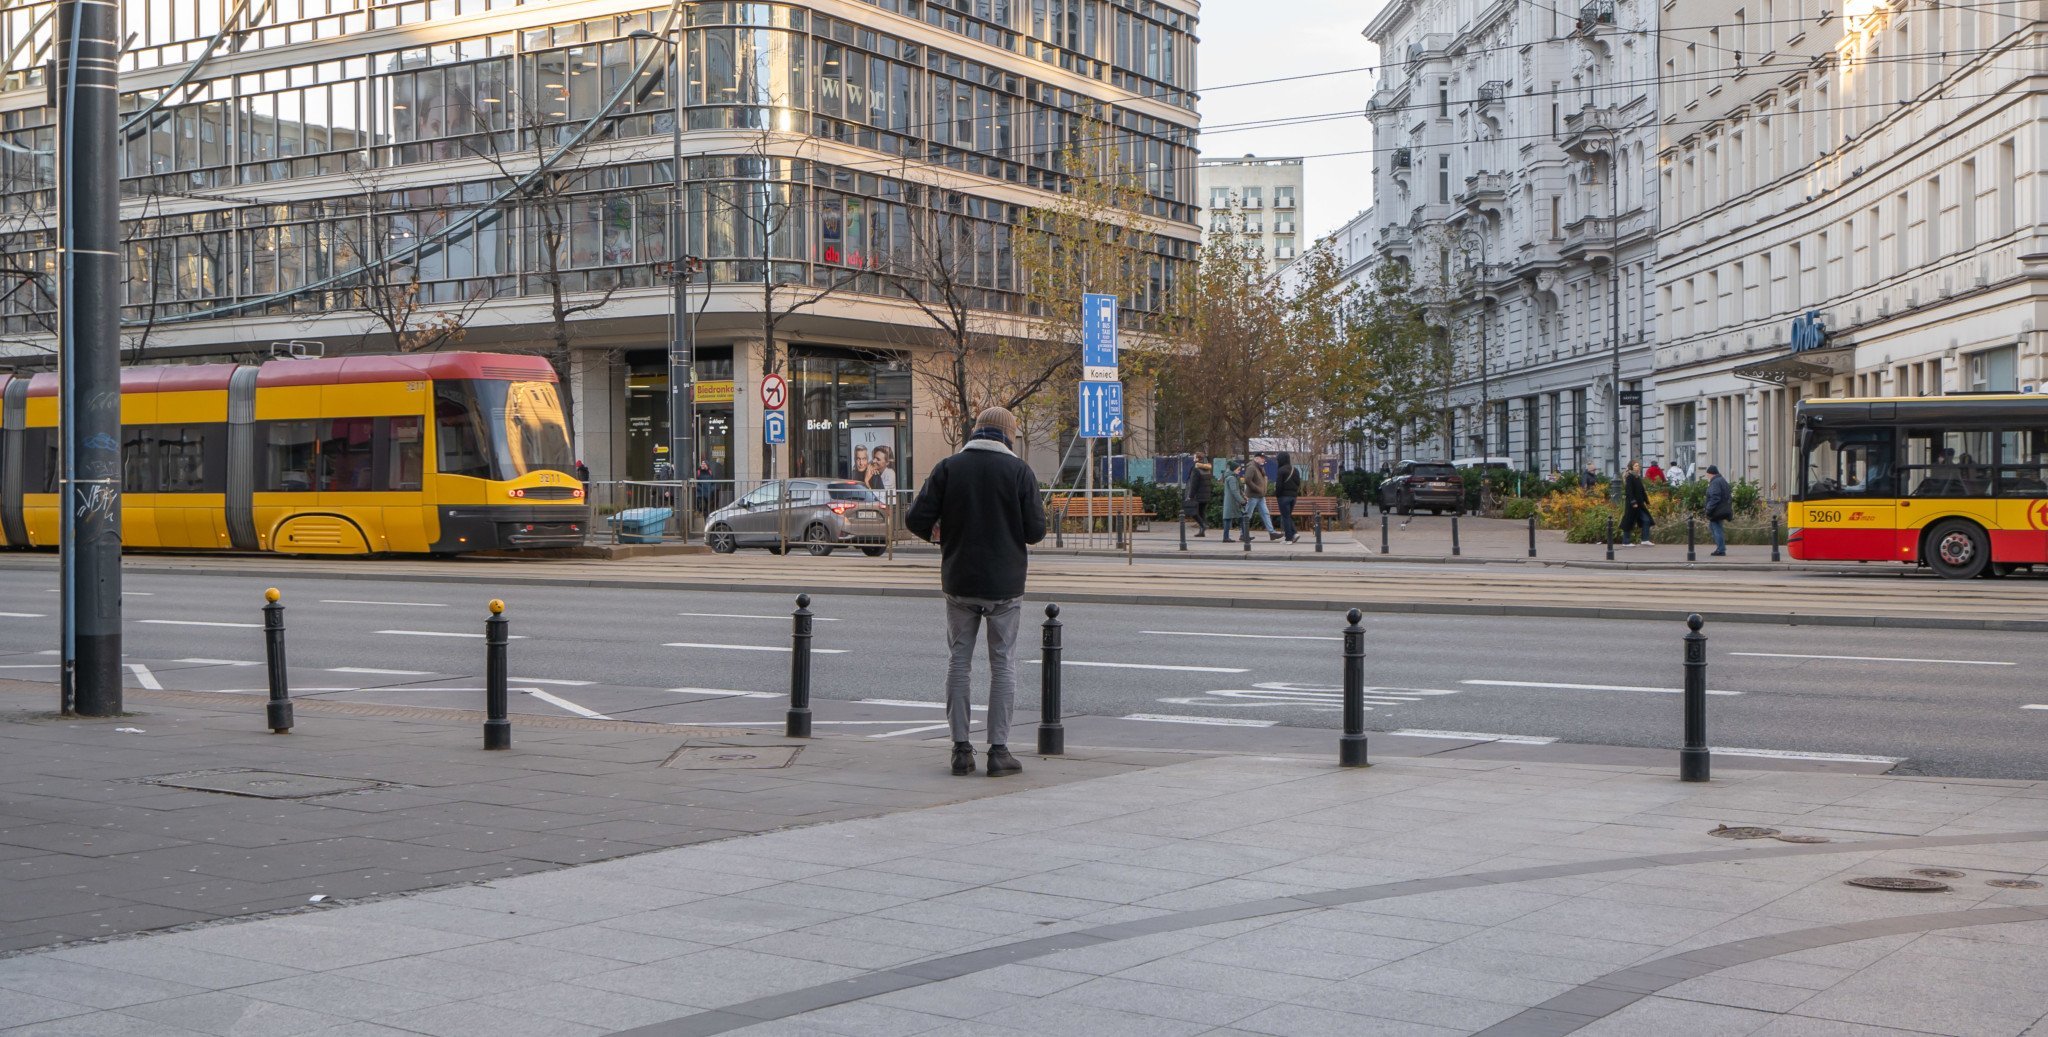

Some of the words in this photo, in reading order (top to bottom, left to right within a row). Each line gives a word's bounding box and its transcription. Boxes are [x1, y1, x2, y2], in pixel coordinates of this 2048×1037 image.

[1090, 368, 1112, 379] Koniec
[769, 420, 780, 440] P
[864, 431, 876, 442] YES
[539, 473, 561, 483] 3211
[1809, 510, 1842, 523] 5260
